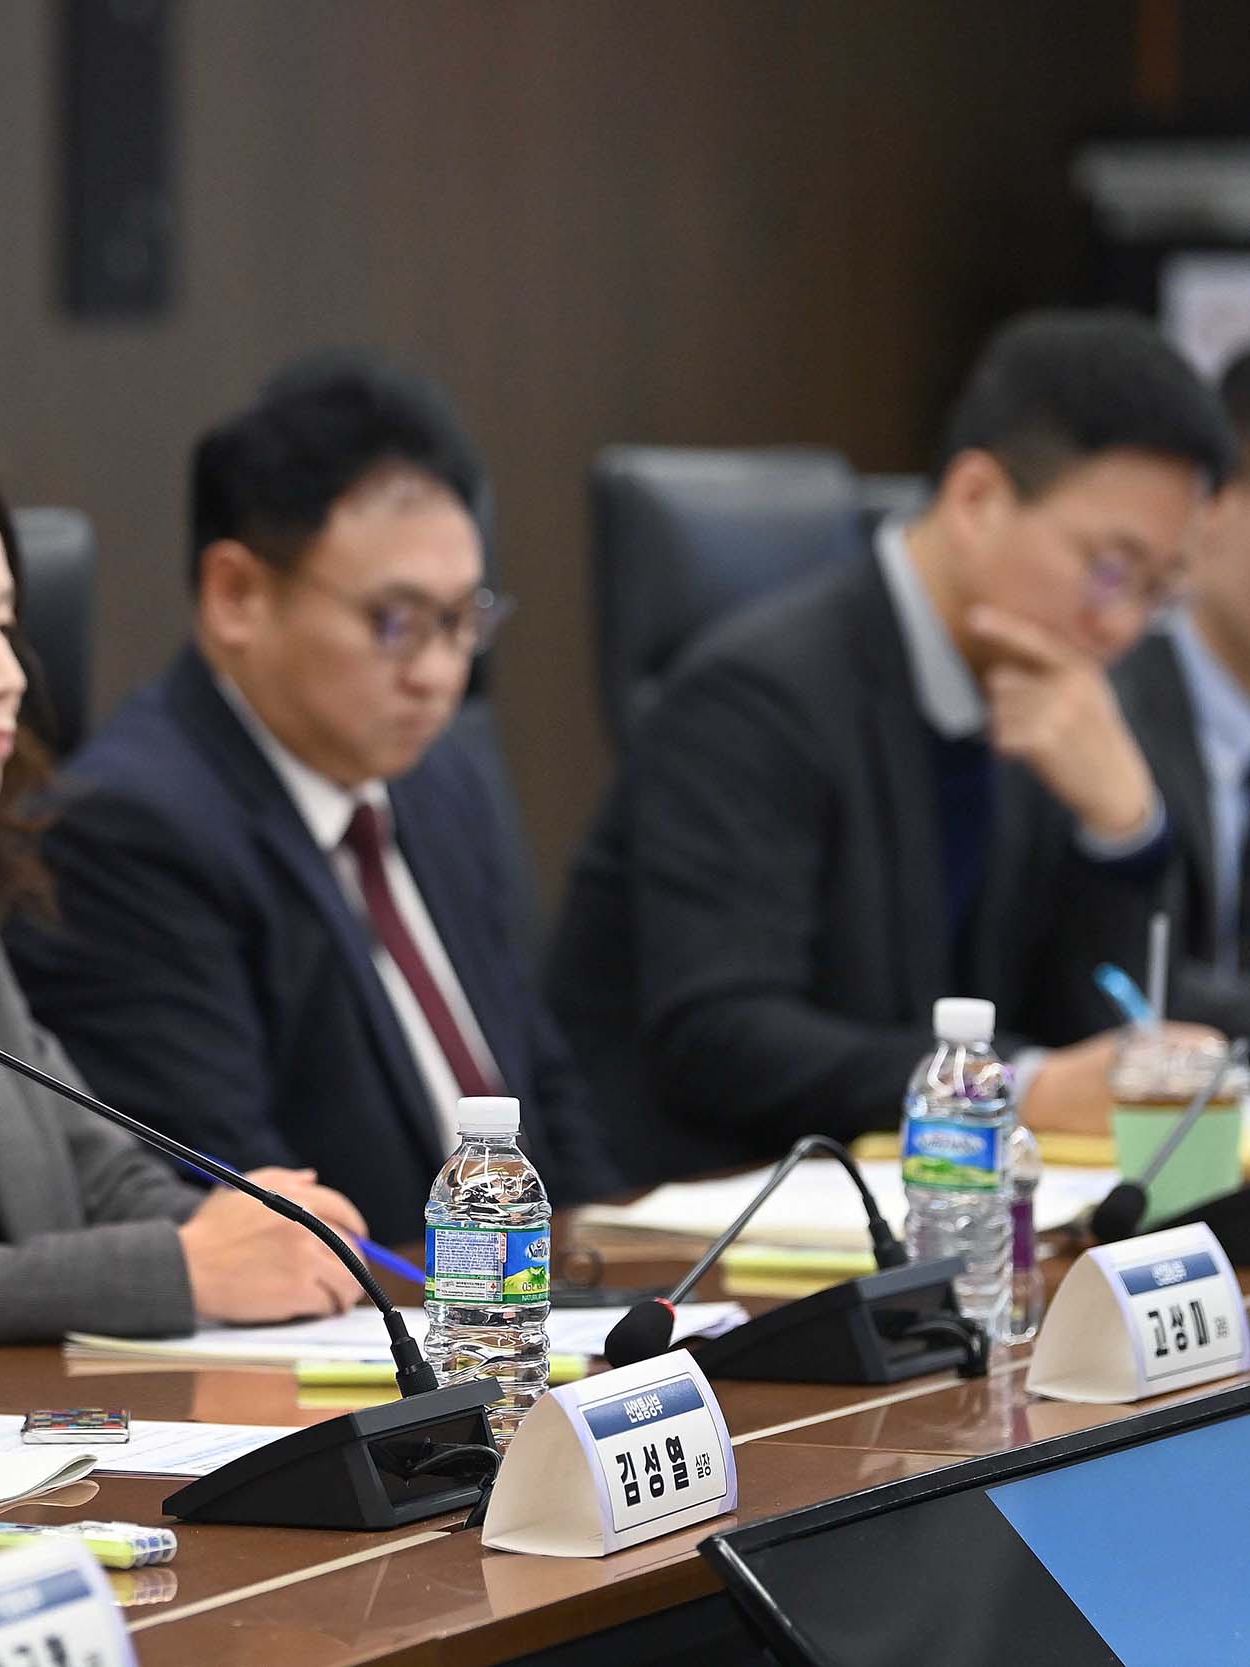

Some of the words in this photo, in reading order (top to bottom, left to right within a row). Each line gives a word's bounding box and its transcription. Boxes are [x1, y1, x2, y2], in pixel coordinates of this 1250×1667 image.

[623, 1393, 663, 1423] 산업통상부
[615, 1436, 690, 1507] 김성열
[695, 1452, 712, 1479] 실장
